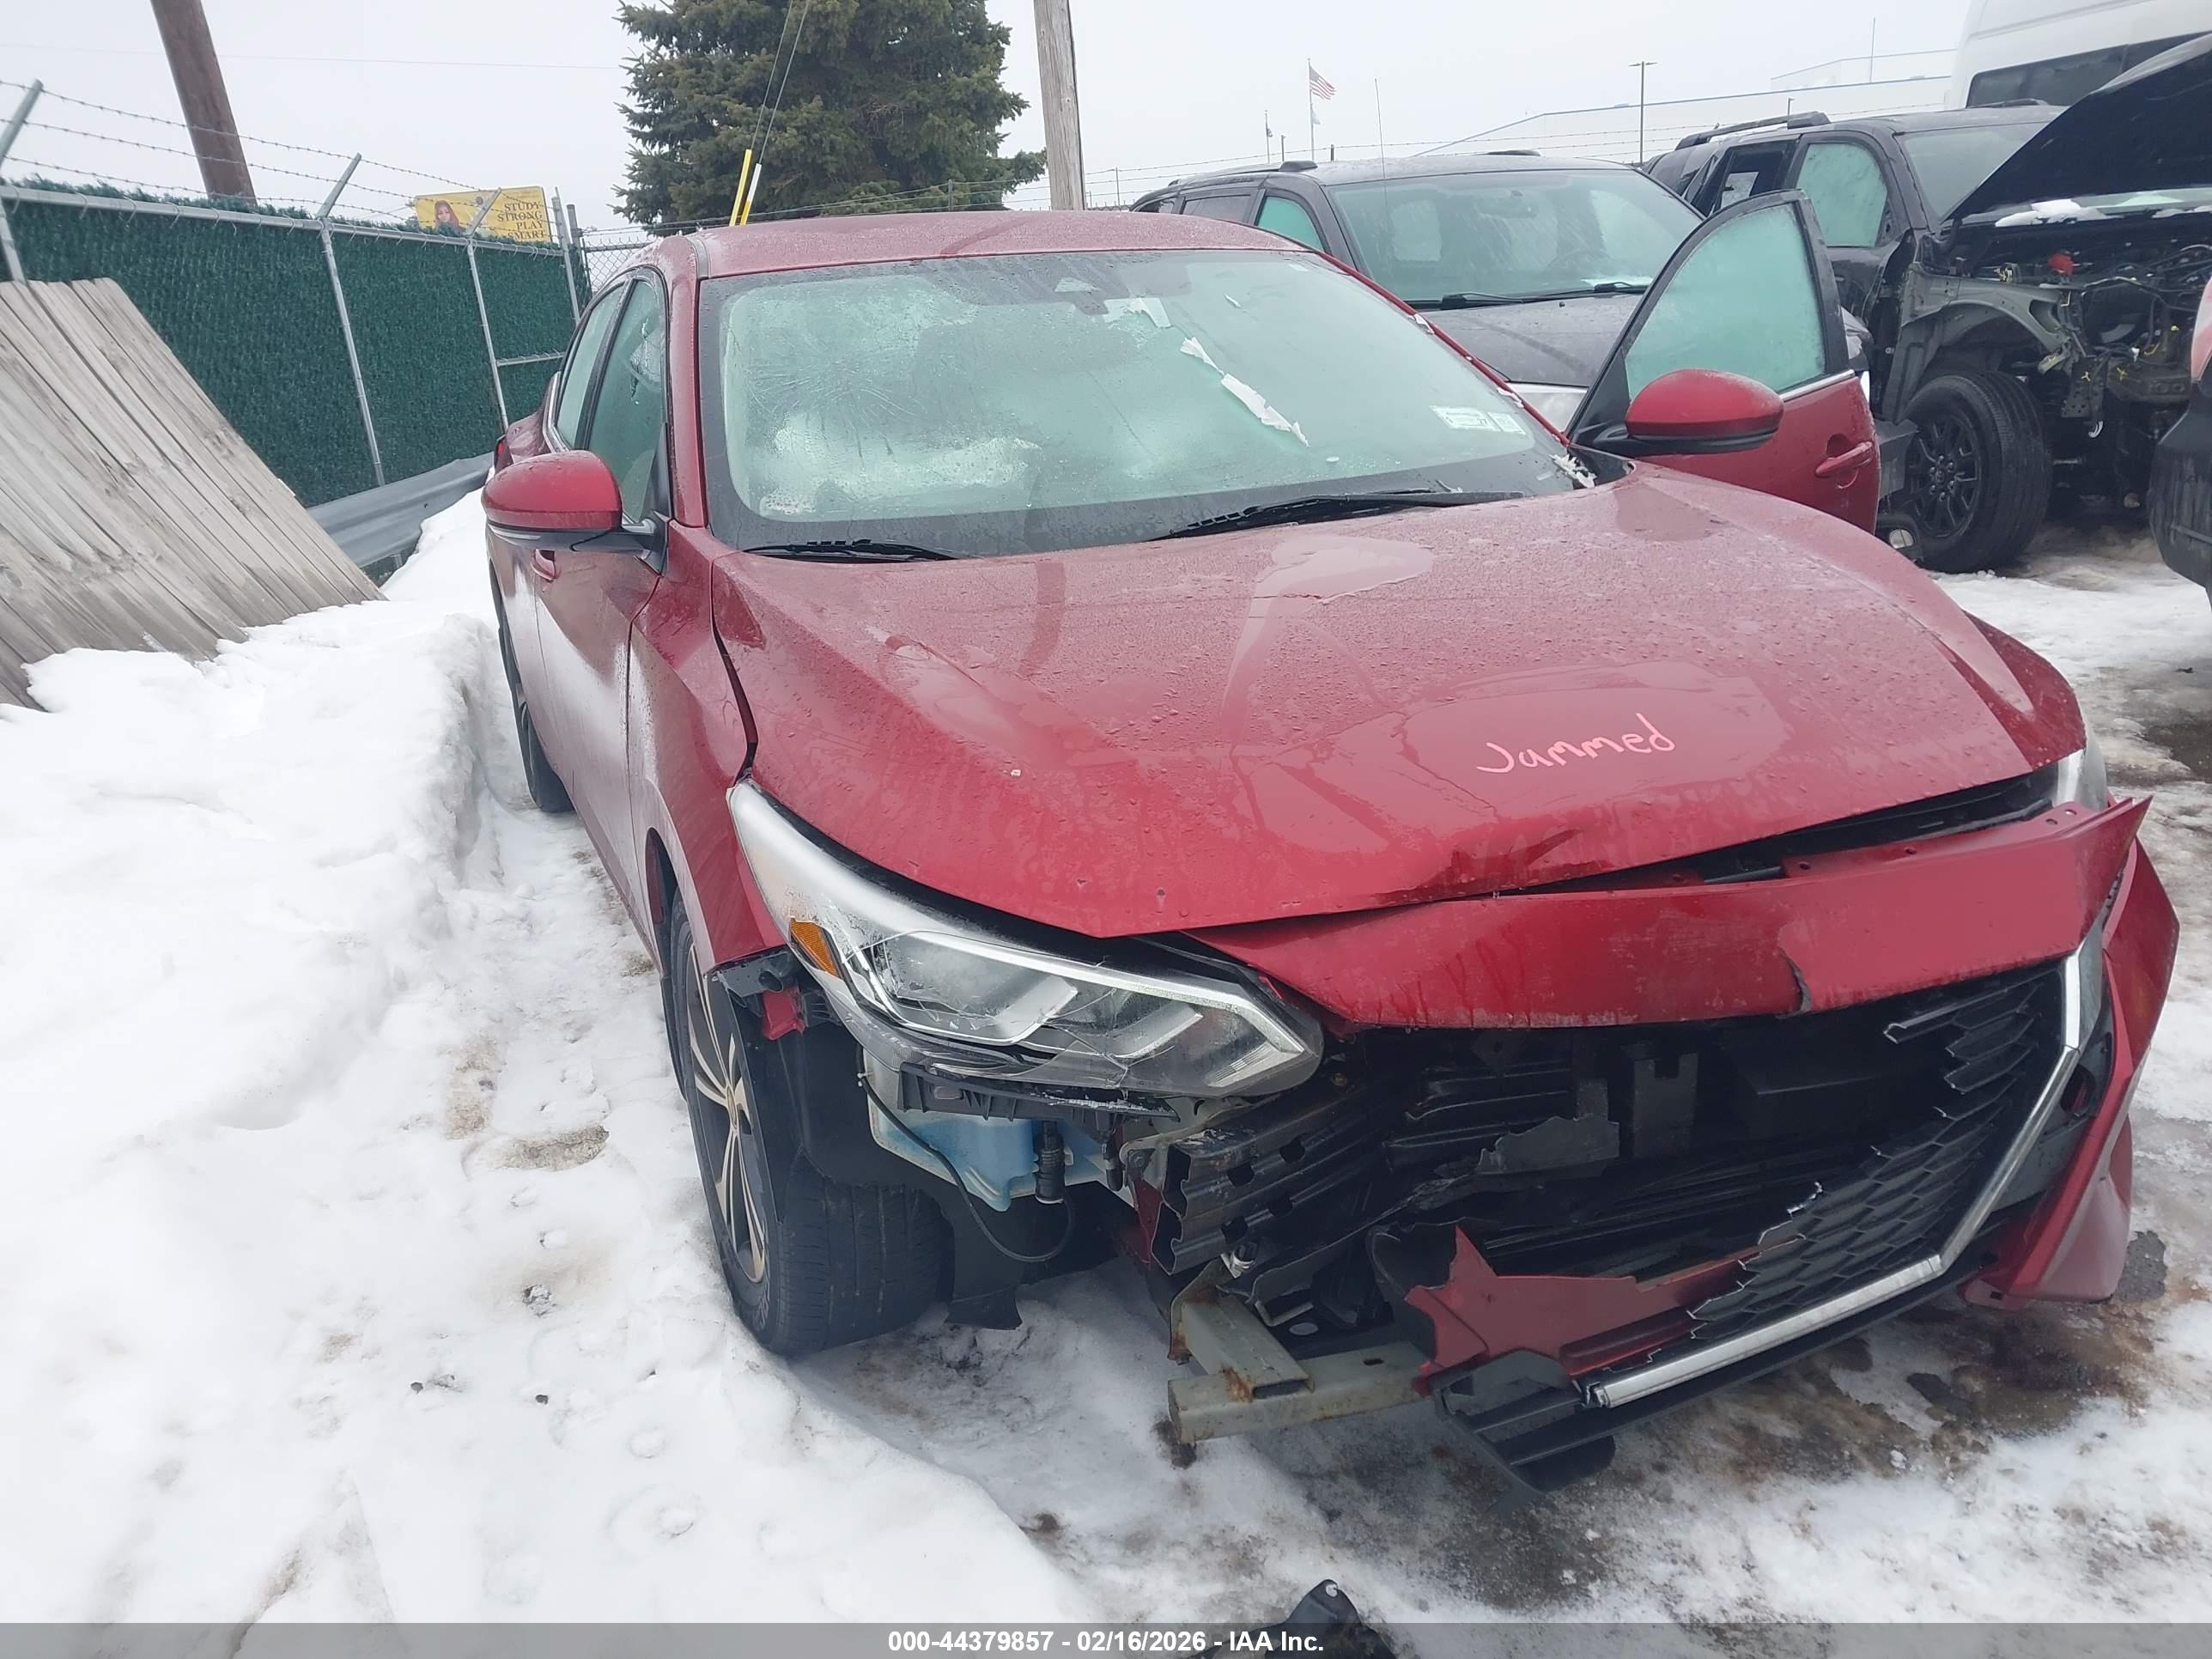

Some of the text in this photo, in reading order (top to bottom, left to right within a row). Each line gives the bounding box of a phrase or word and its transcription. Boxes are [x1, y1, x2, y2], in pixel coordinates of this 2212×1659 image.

[504, 202, 541, 211] STUDY
[497, 210, 543, 222] STRONG
[516, 220, 544, 230] PLAY
[507, 230, 545, 240] SMART
[1476, 713, 1675, 773] Jammed
